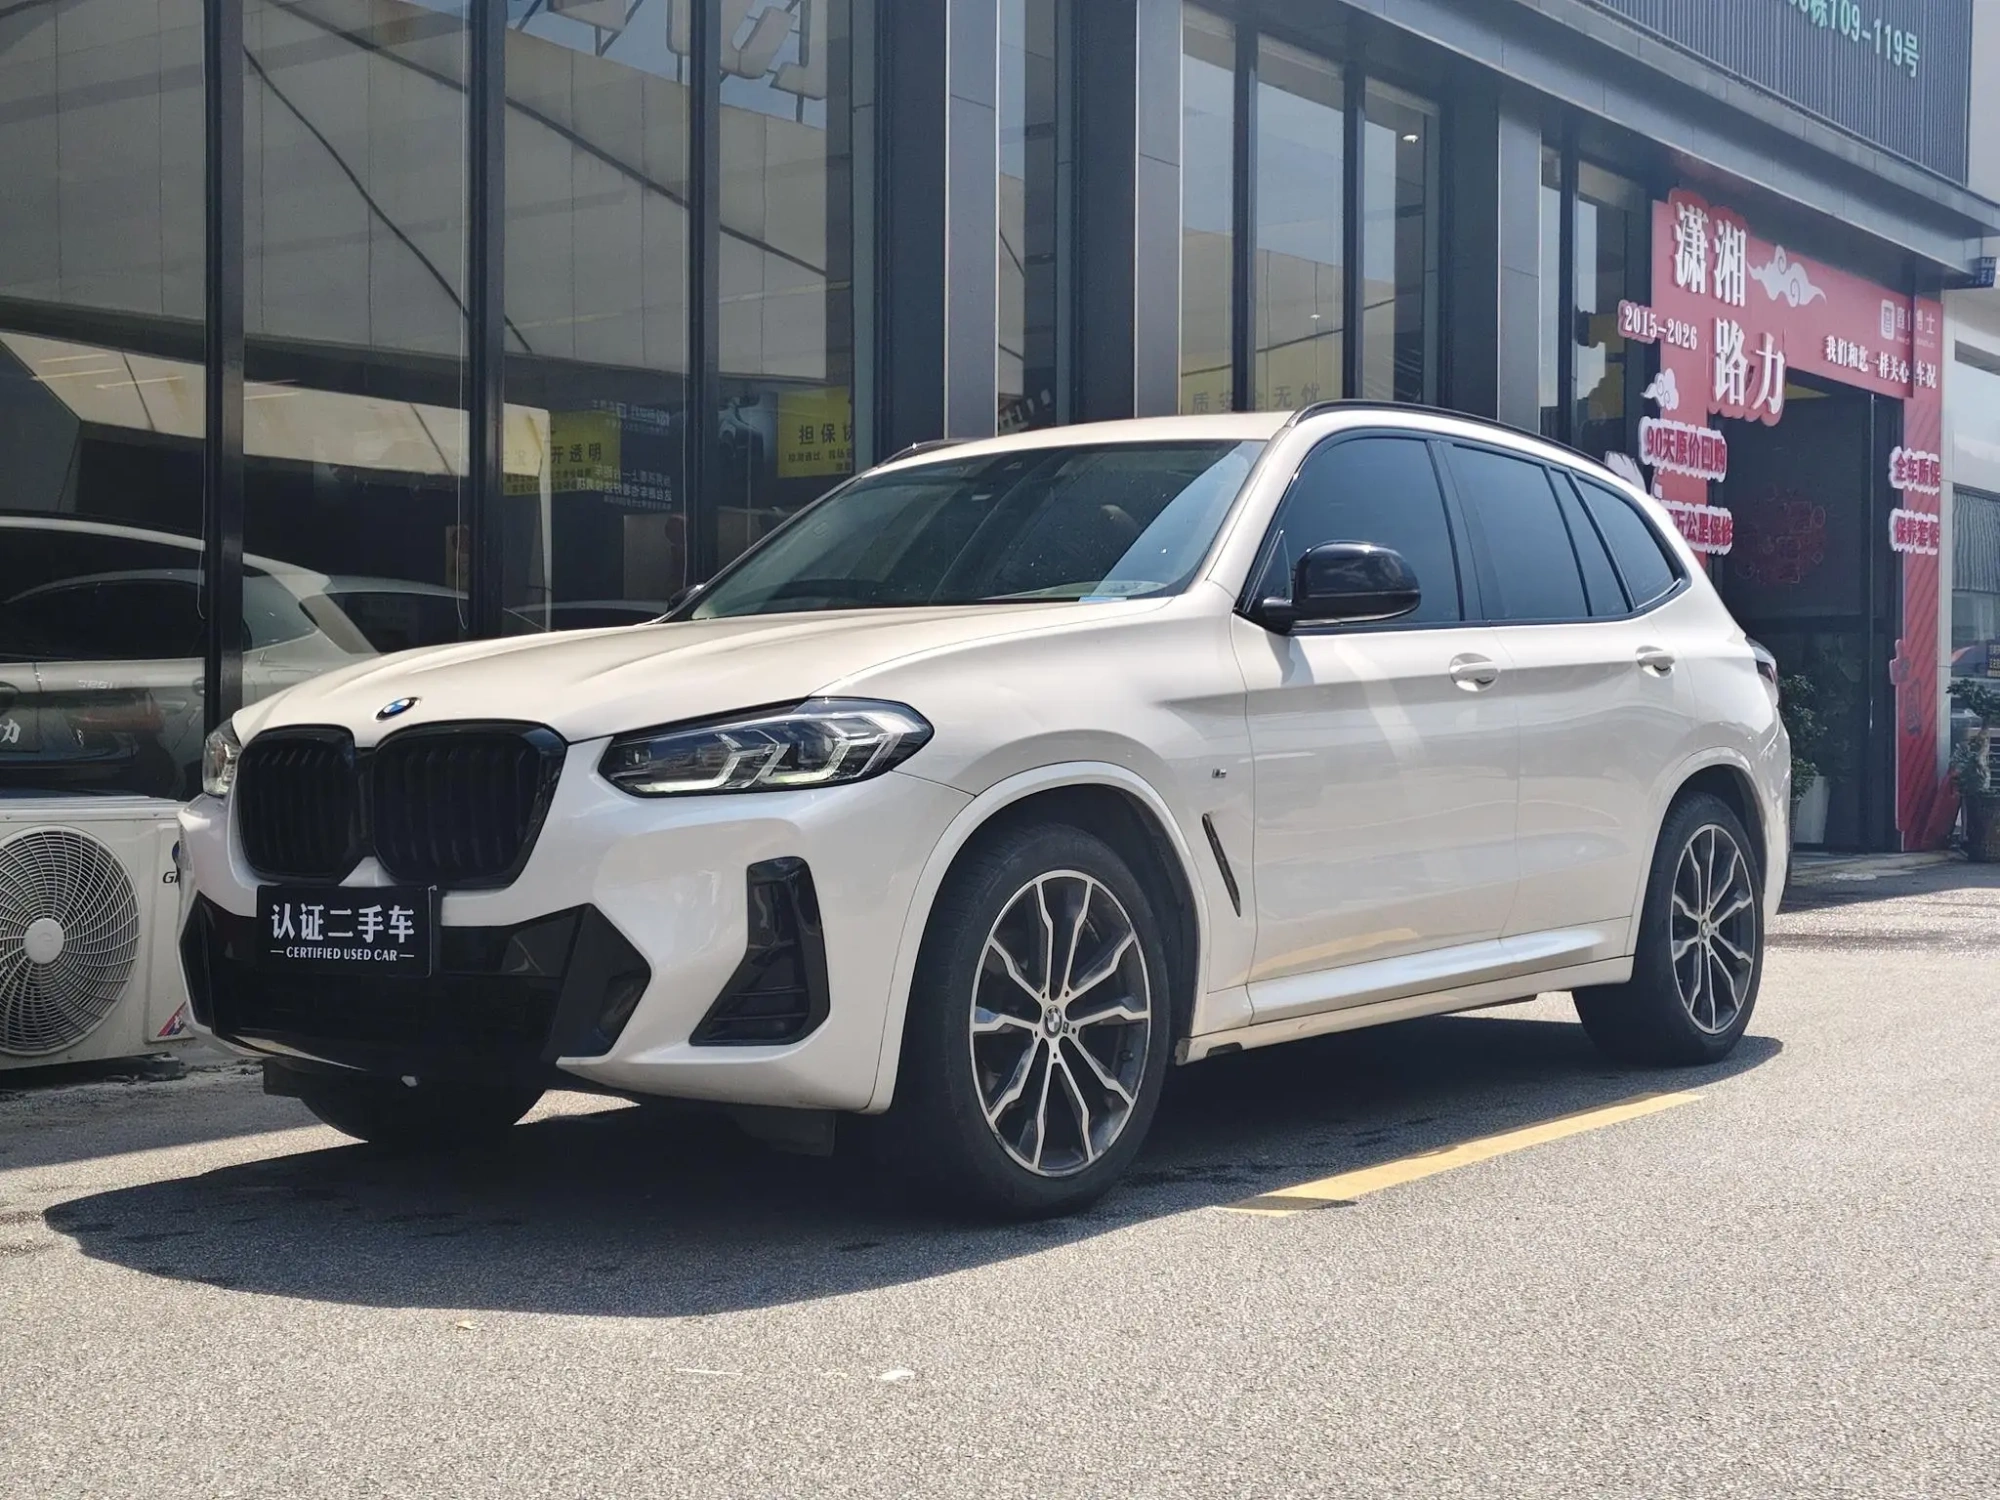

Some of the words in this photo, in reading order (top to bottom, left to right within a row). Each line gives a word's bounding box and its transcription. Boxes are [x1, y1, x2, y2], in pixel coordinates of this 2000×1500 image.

[1789, 0, 1920, 78] 栋109-119号
[1673, 202, 1748, 307] 潇湘
[1624, 305, 1698, 350] 2015-2026
[1646, 425, 1727, 474] 90天原价回购
[1668, 508, 1734, 547] 万公里保修
[271, 902, 415, 944] 认证二手车
[286, 946, 341, 960] CERTIFIED
[344, 948, 371, 961] USED
[374, 949, 398, 962] CAR
